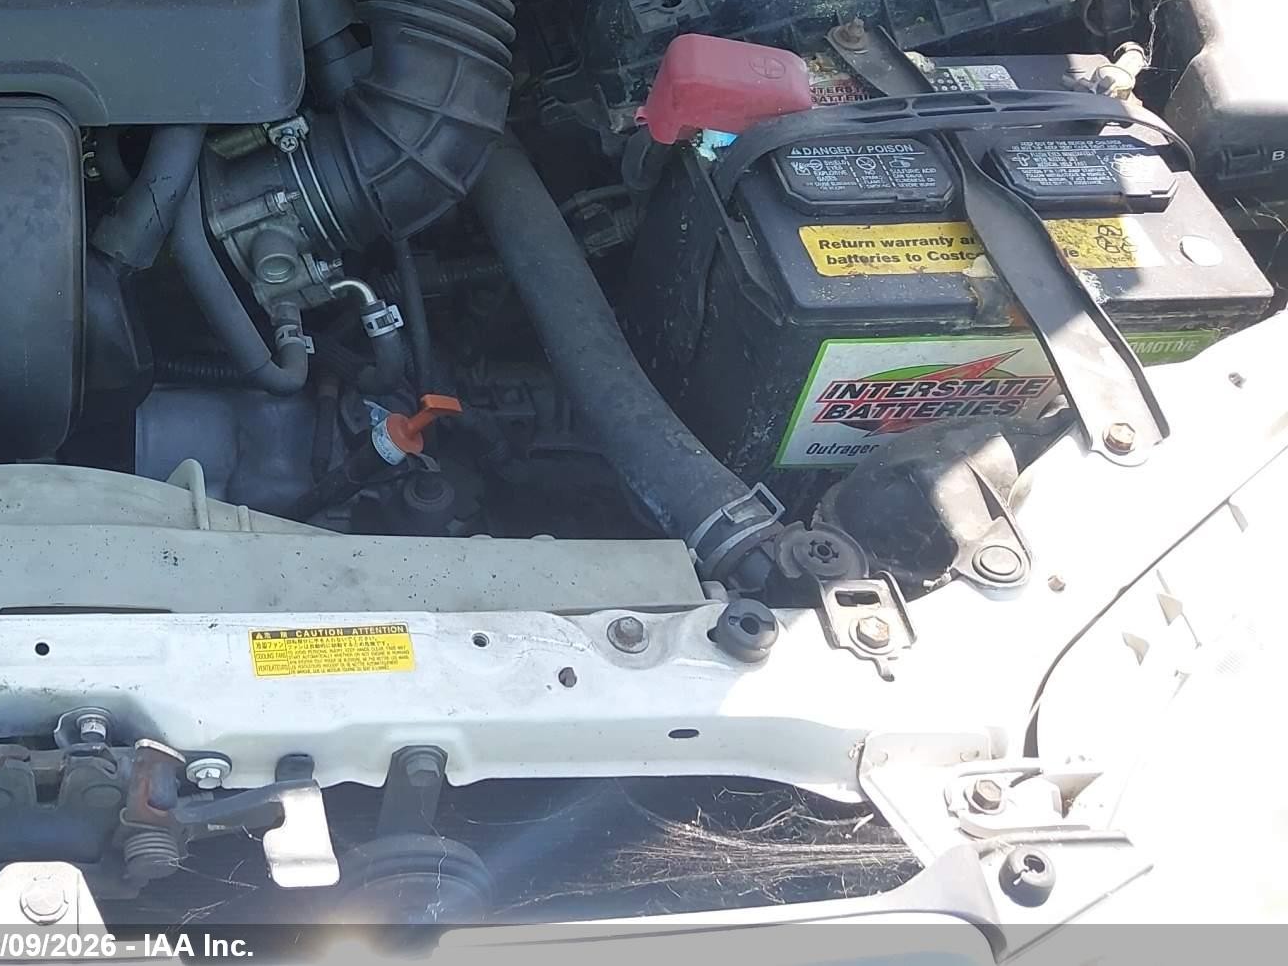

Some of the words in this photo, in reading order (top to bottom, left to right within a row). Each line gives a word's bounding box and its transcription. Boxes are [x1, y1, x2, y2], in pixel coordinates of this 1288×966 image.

[802, 146, 855, 155] DANGER
[867, 144, 914, 153] POISON
[1272, 150, 1286, 161] B
[819, 238, 875, 250] Return
[880, 236, 954, 248] warranty
[827, 253, 901, 265] batteries
[905, 252, 922, 263] to
[823, 381, 1043, 400] INTERSTATE
[821, 400, 1020, 420] BATTERIES
[295, 629, 344, 638] CAUTION
[352, 625, 404, 635] ATTENTION
